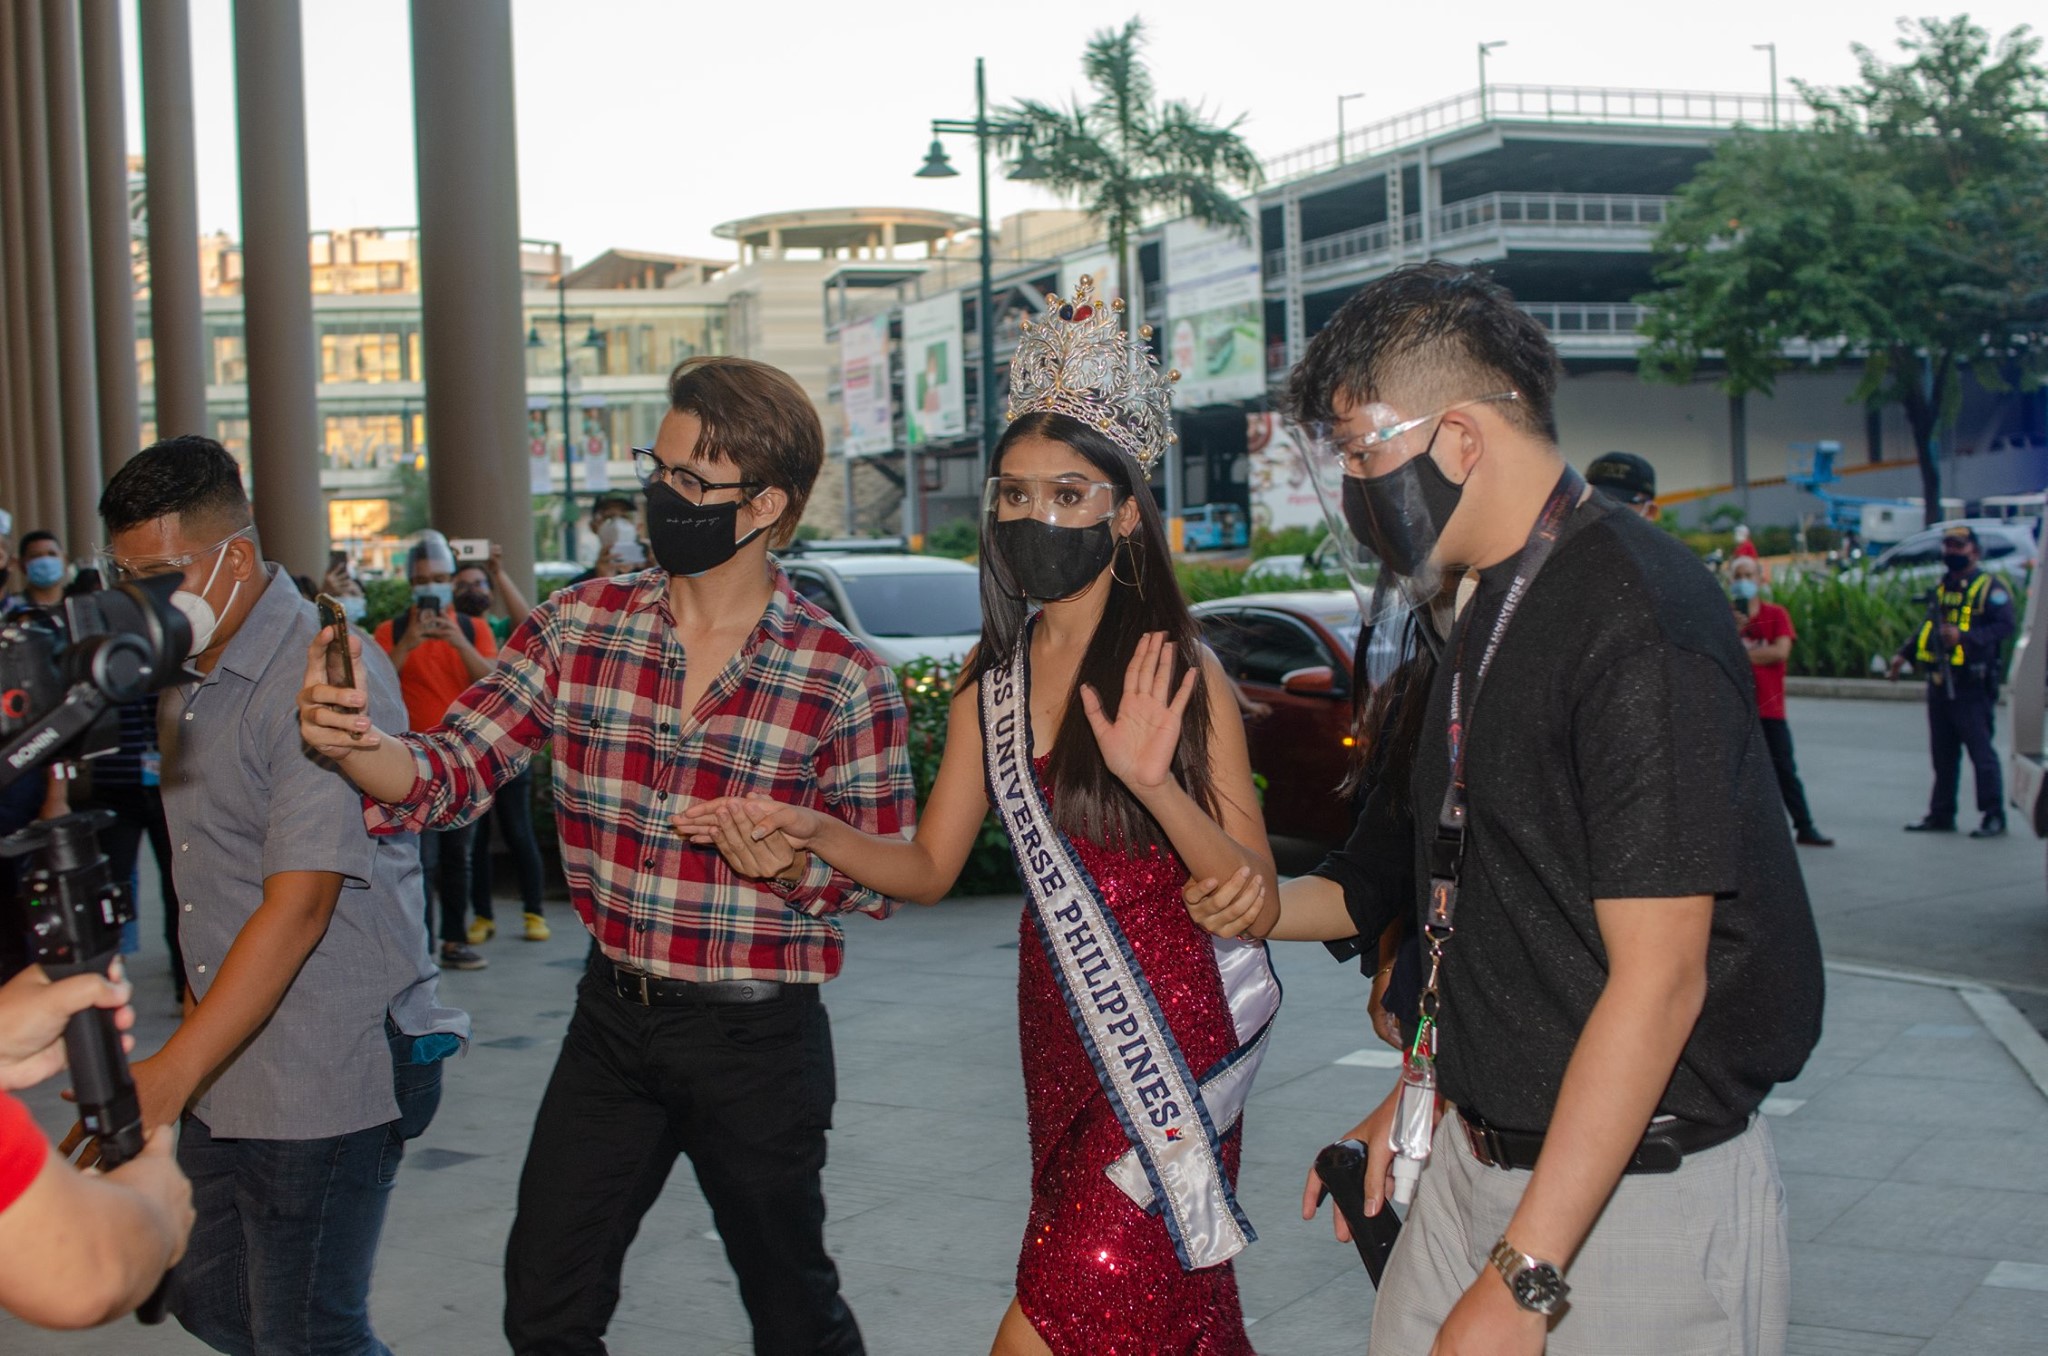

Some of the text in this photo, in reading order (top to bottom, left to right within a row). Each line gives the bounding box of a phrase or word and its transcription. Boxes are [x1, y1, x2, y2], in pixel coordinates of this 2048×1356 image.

[1490, 575, 1526, 643] UNIVERSE
[993, 664, 1182, 1128] SS UNIVERSE PHILIPPINES
